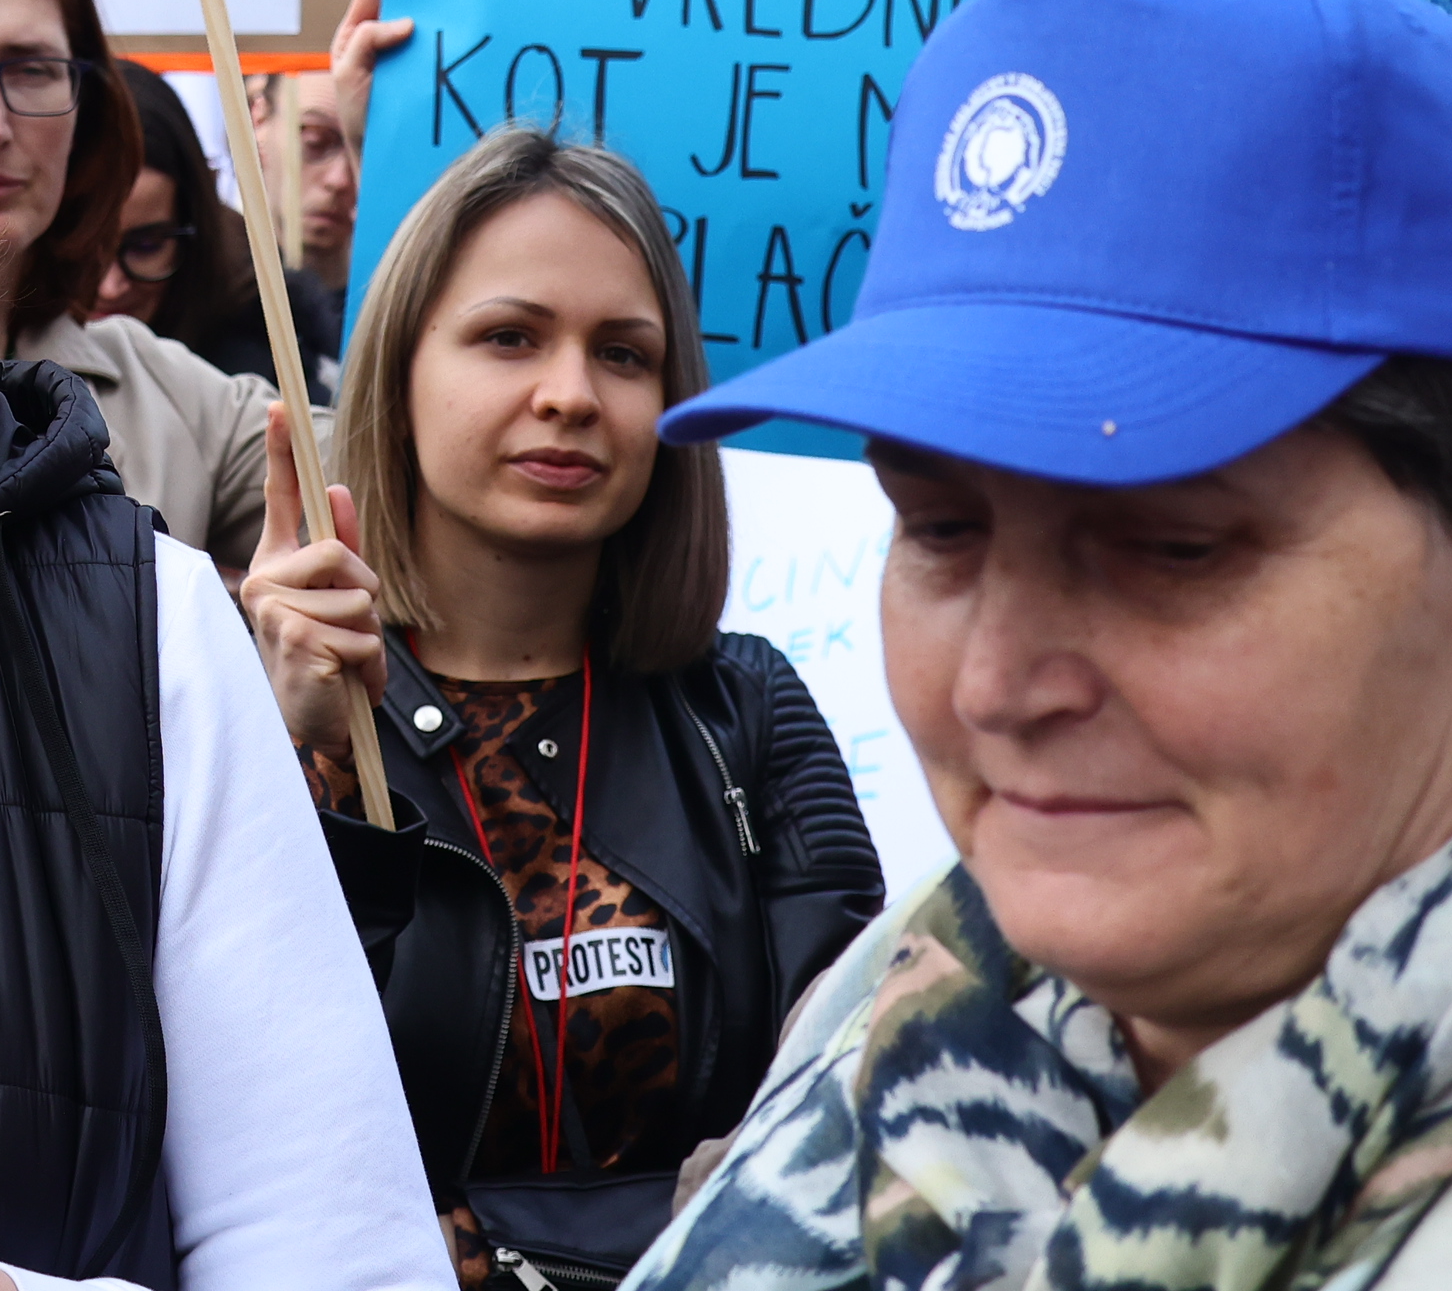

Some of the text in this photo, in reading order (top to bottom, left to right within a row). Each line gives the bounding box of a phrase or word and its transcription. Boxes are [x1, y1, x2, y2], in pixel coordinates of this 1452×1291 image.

[432, 30, 644, 150] KOT
[690, 62, 791, 181] JE
[533, 936, 655, 991] PROTEST
